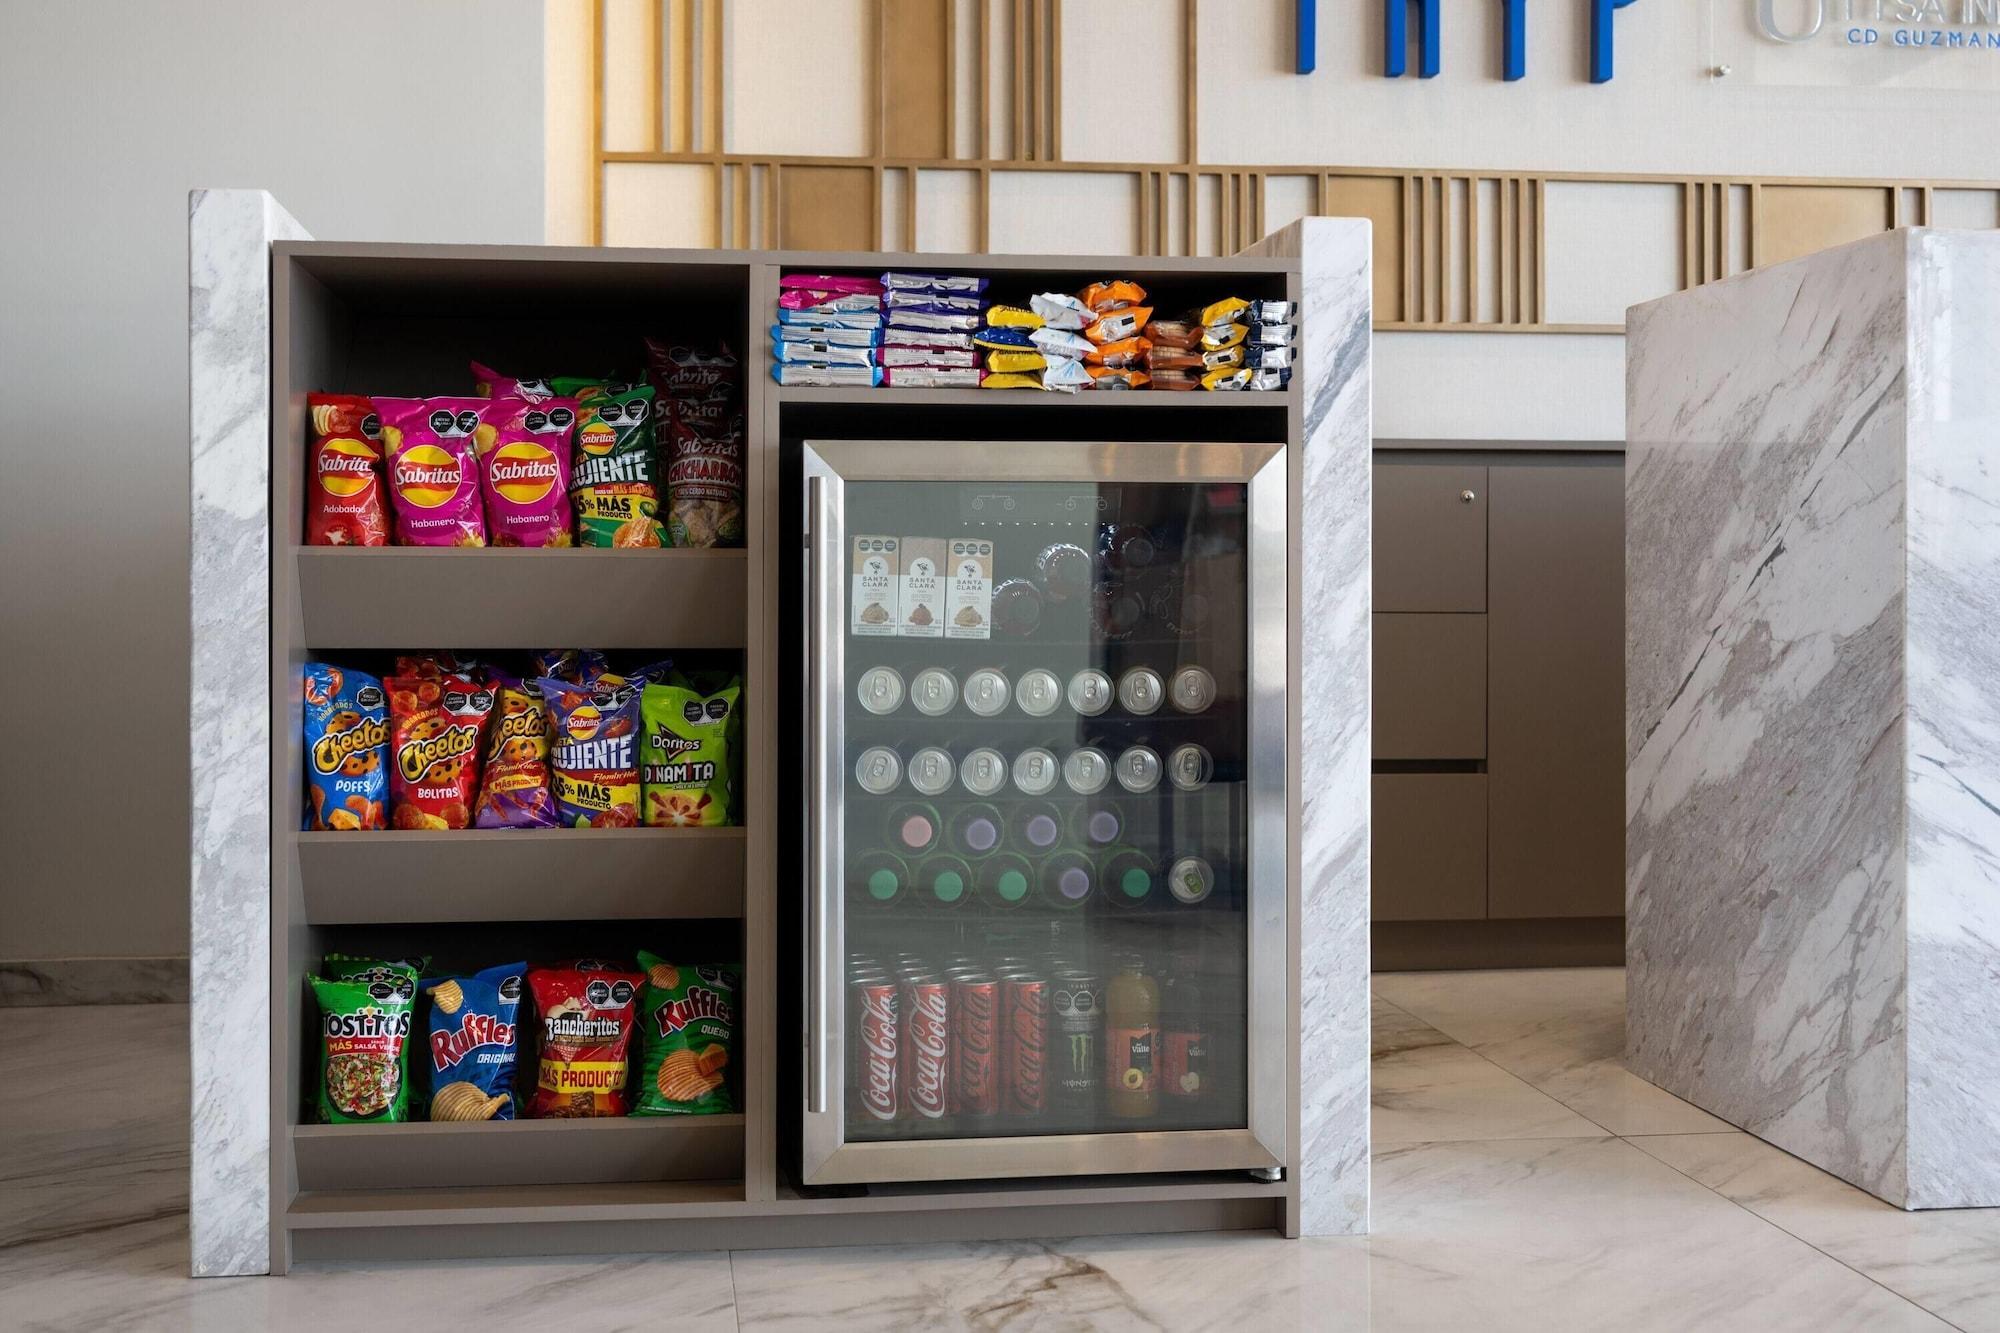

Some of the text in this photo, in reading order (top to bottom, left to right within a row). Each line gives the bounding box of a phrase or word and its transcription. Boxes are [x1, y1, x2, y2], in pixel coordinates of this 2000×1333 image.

[1847, 28, 2000, 49] CD GUZMAN
[580, 432, 616, 445] Sabritas
[318, 454, 372, 473] Sabrita
[395, 465, 460, 485] Sabritas
[490, 461, 557, 482] Sabritas
[323, 504, 365, 514] Adobados
[596, 496, 631, 512] MÁS
[506, 514, 550, 524] Habanero
[597, 509, 632, 519] PRODUCTO
[411, 517, 455, 529] Habanero
[567, 717, 601, 730] Sabritas
[652, 735, 700, 750] Doritos
[399, 724, 478, 783] Cheetos
[551, 734, 633, 770] RUJIENTE
[335, 779, 371, 793] POFFS
[417, 786, 459, 799] BOLITAS
[577, 782, 611, 802] MÁS
[576, 797, 612, 810] PRODUCTO
[544, 1014, 620, 1041] Rancheritos
[701, 1024, 730, 1039] QUESO
[329, 1039, 352, 1052] MÁS
[430, 1013, 516, 1073] Ruffles
